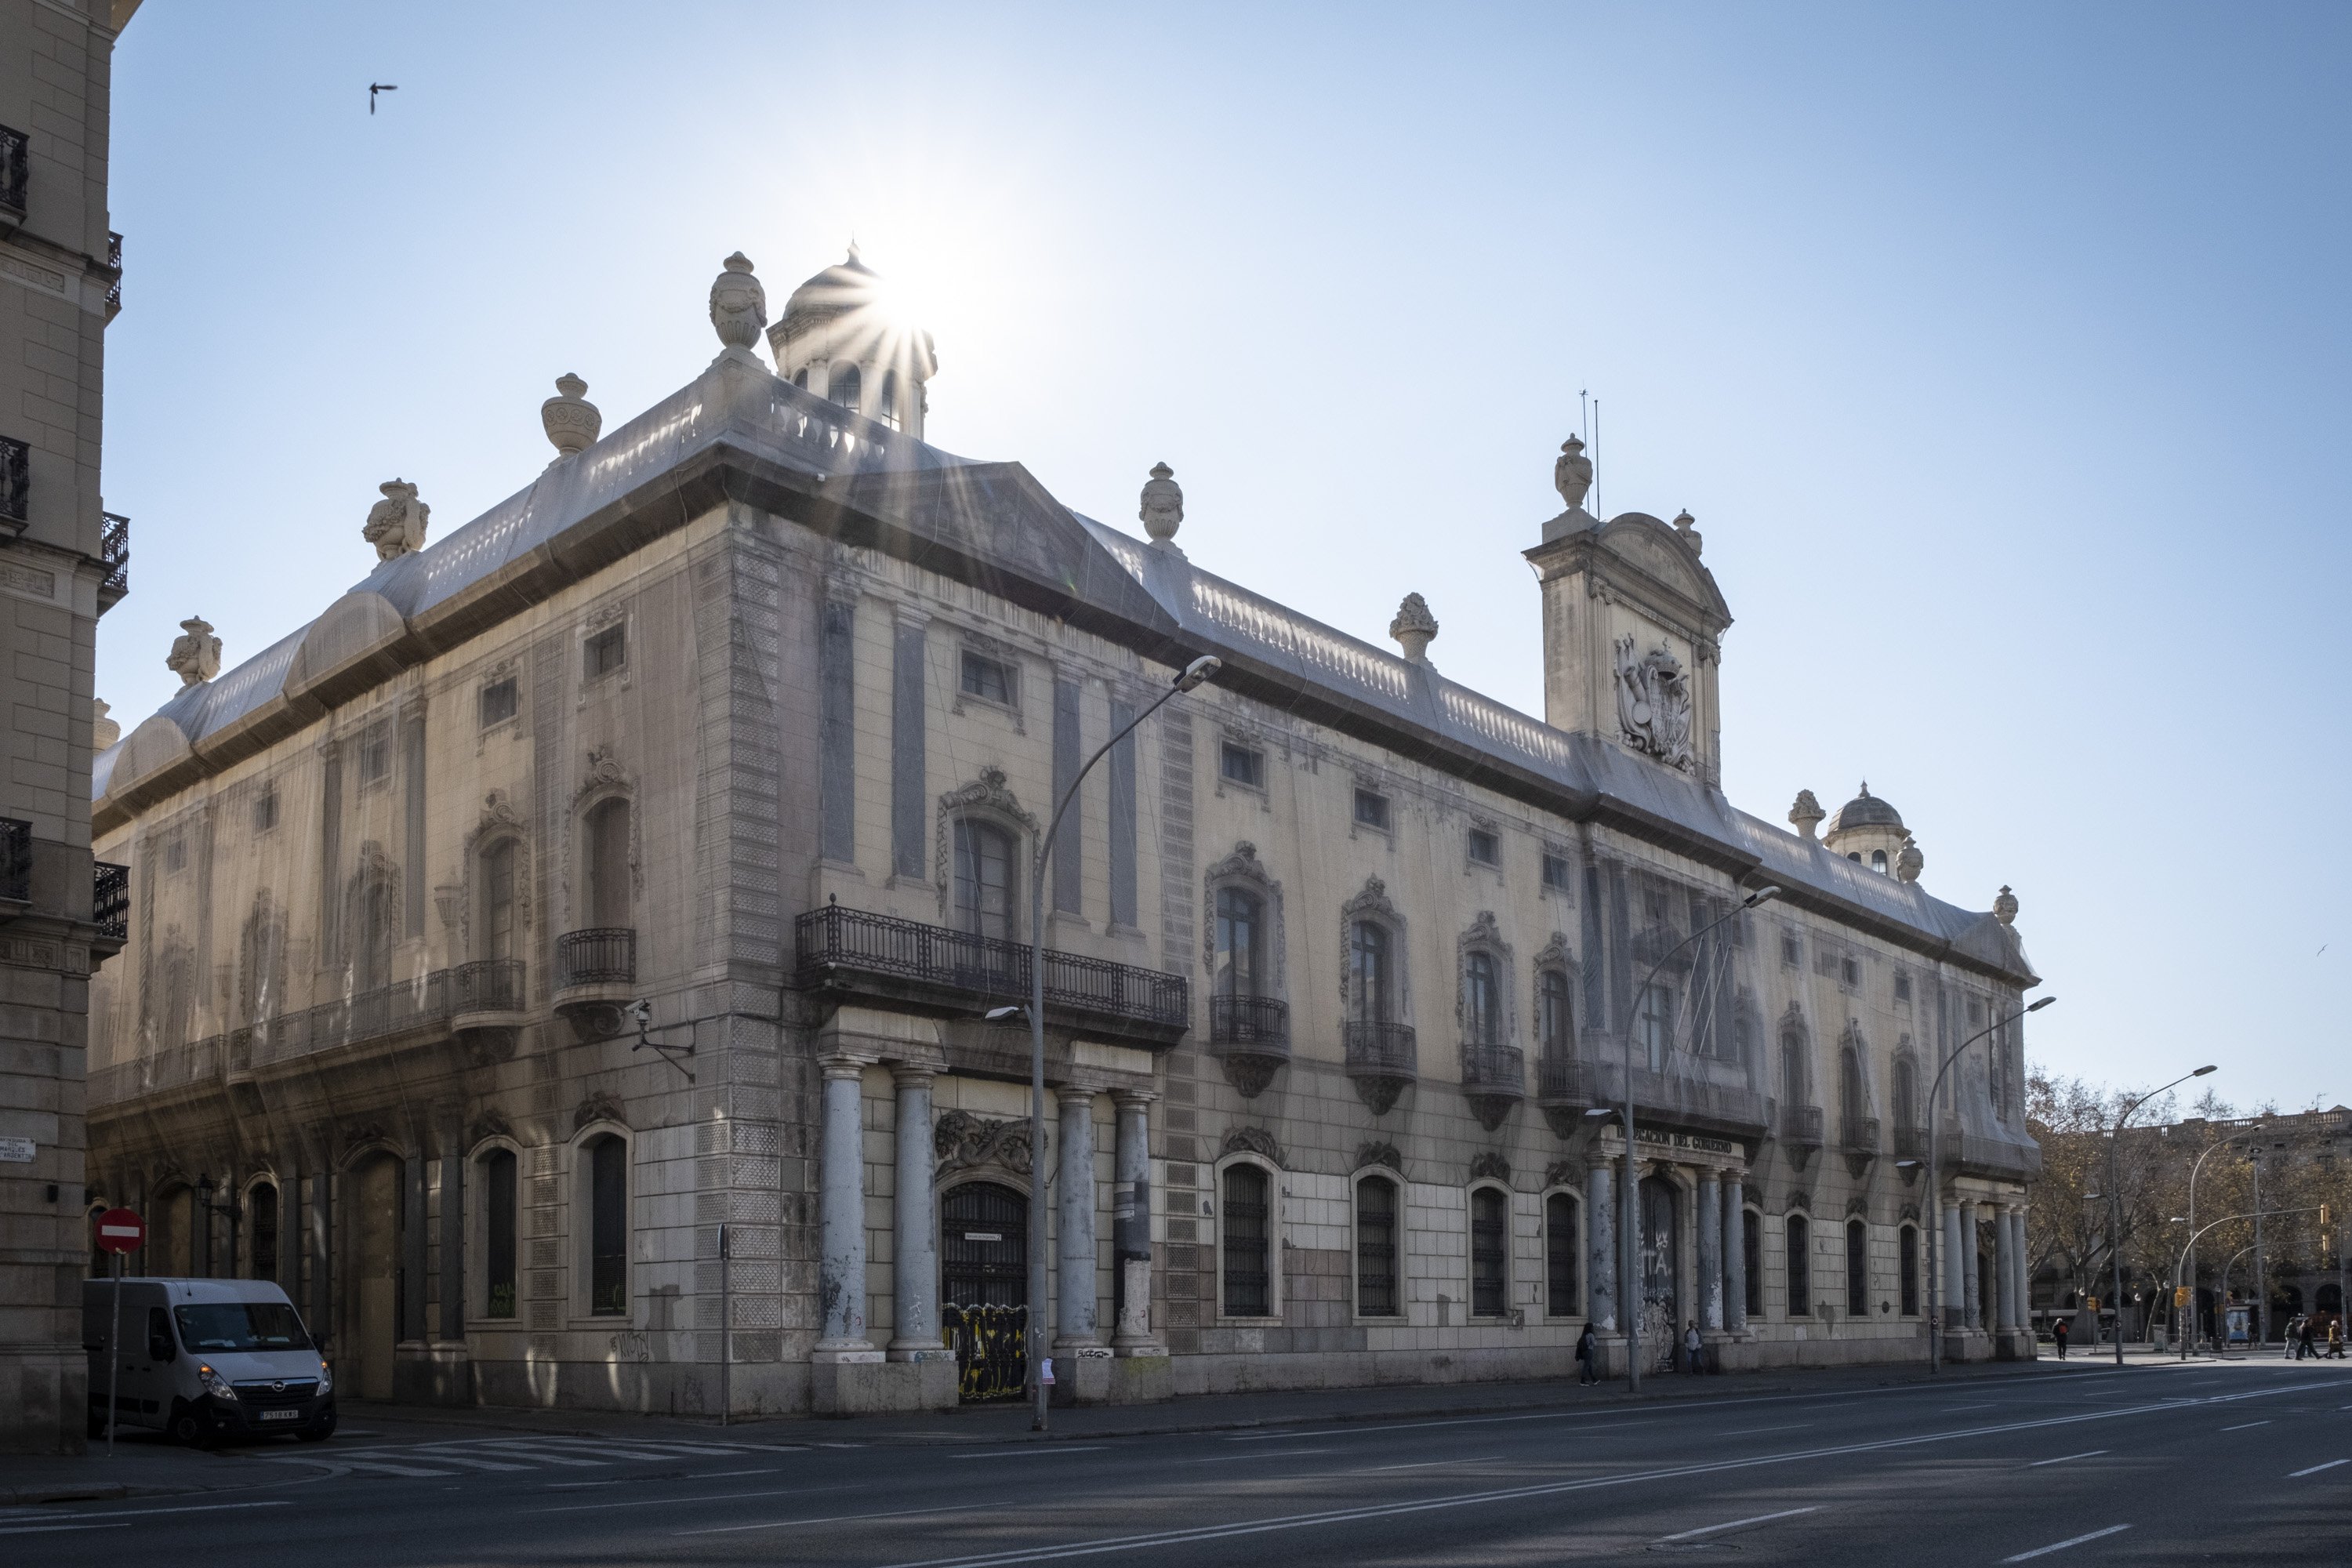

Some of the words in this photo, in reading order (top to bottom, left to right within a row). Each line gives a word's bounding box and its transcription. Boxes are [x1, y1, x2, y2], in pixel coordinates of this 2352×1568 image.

[1617, 1125, 1671, 1145] DEGACION
[1674, 1134, 1690, 1148] DEL
[1693, 1136, 1732, 1153] GOBIERNO
